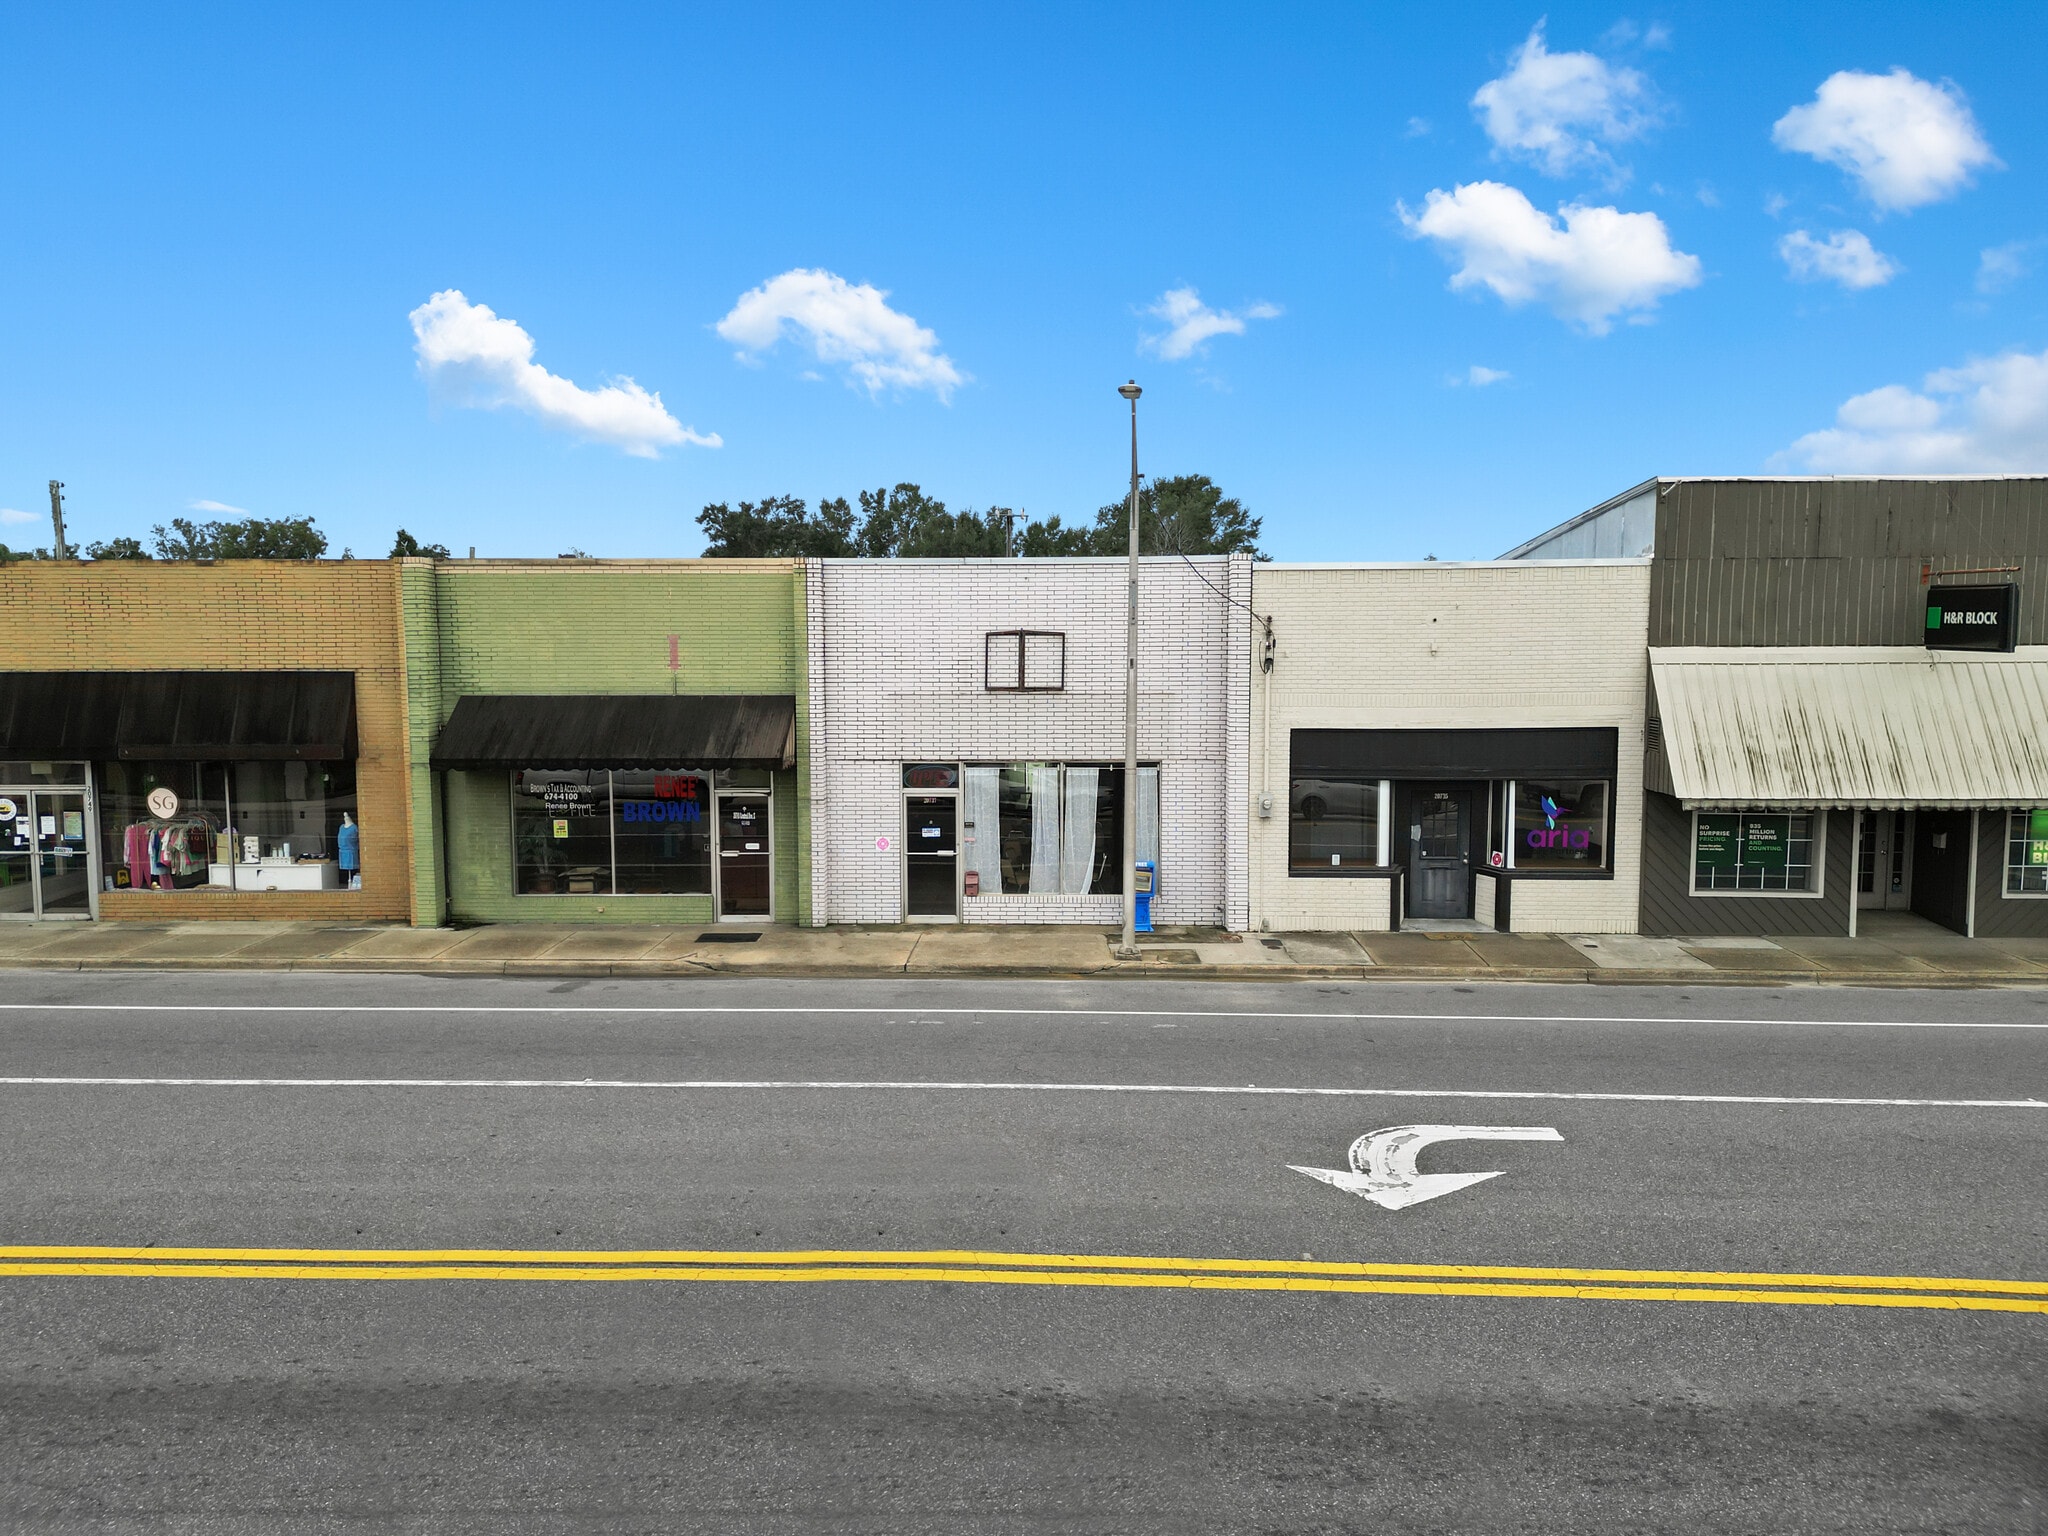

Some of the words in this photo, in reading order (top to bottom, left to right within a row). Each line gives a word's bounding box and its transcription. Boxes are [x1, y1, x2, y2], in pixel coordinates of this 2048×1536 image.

[1943, 611, 1963, 624] H&R
[1965, 611, 1998, 625] BLOCK
[152, 795, 174, 810] SG
[545, 802, 568, 810] Renee
[569, 802, 591, 810] Brown
[623, 801, 701, 823] BROWN
[1526, 823, 1590, 848] aria
